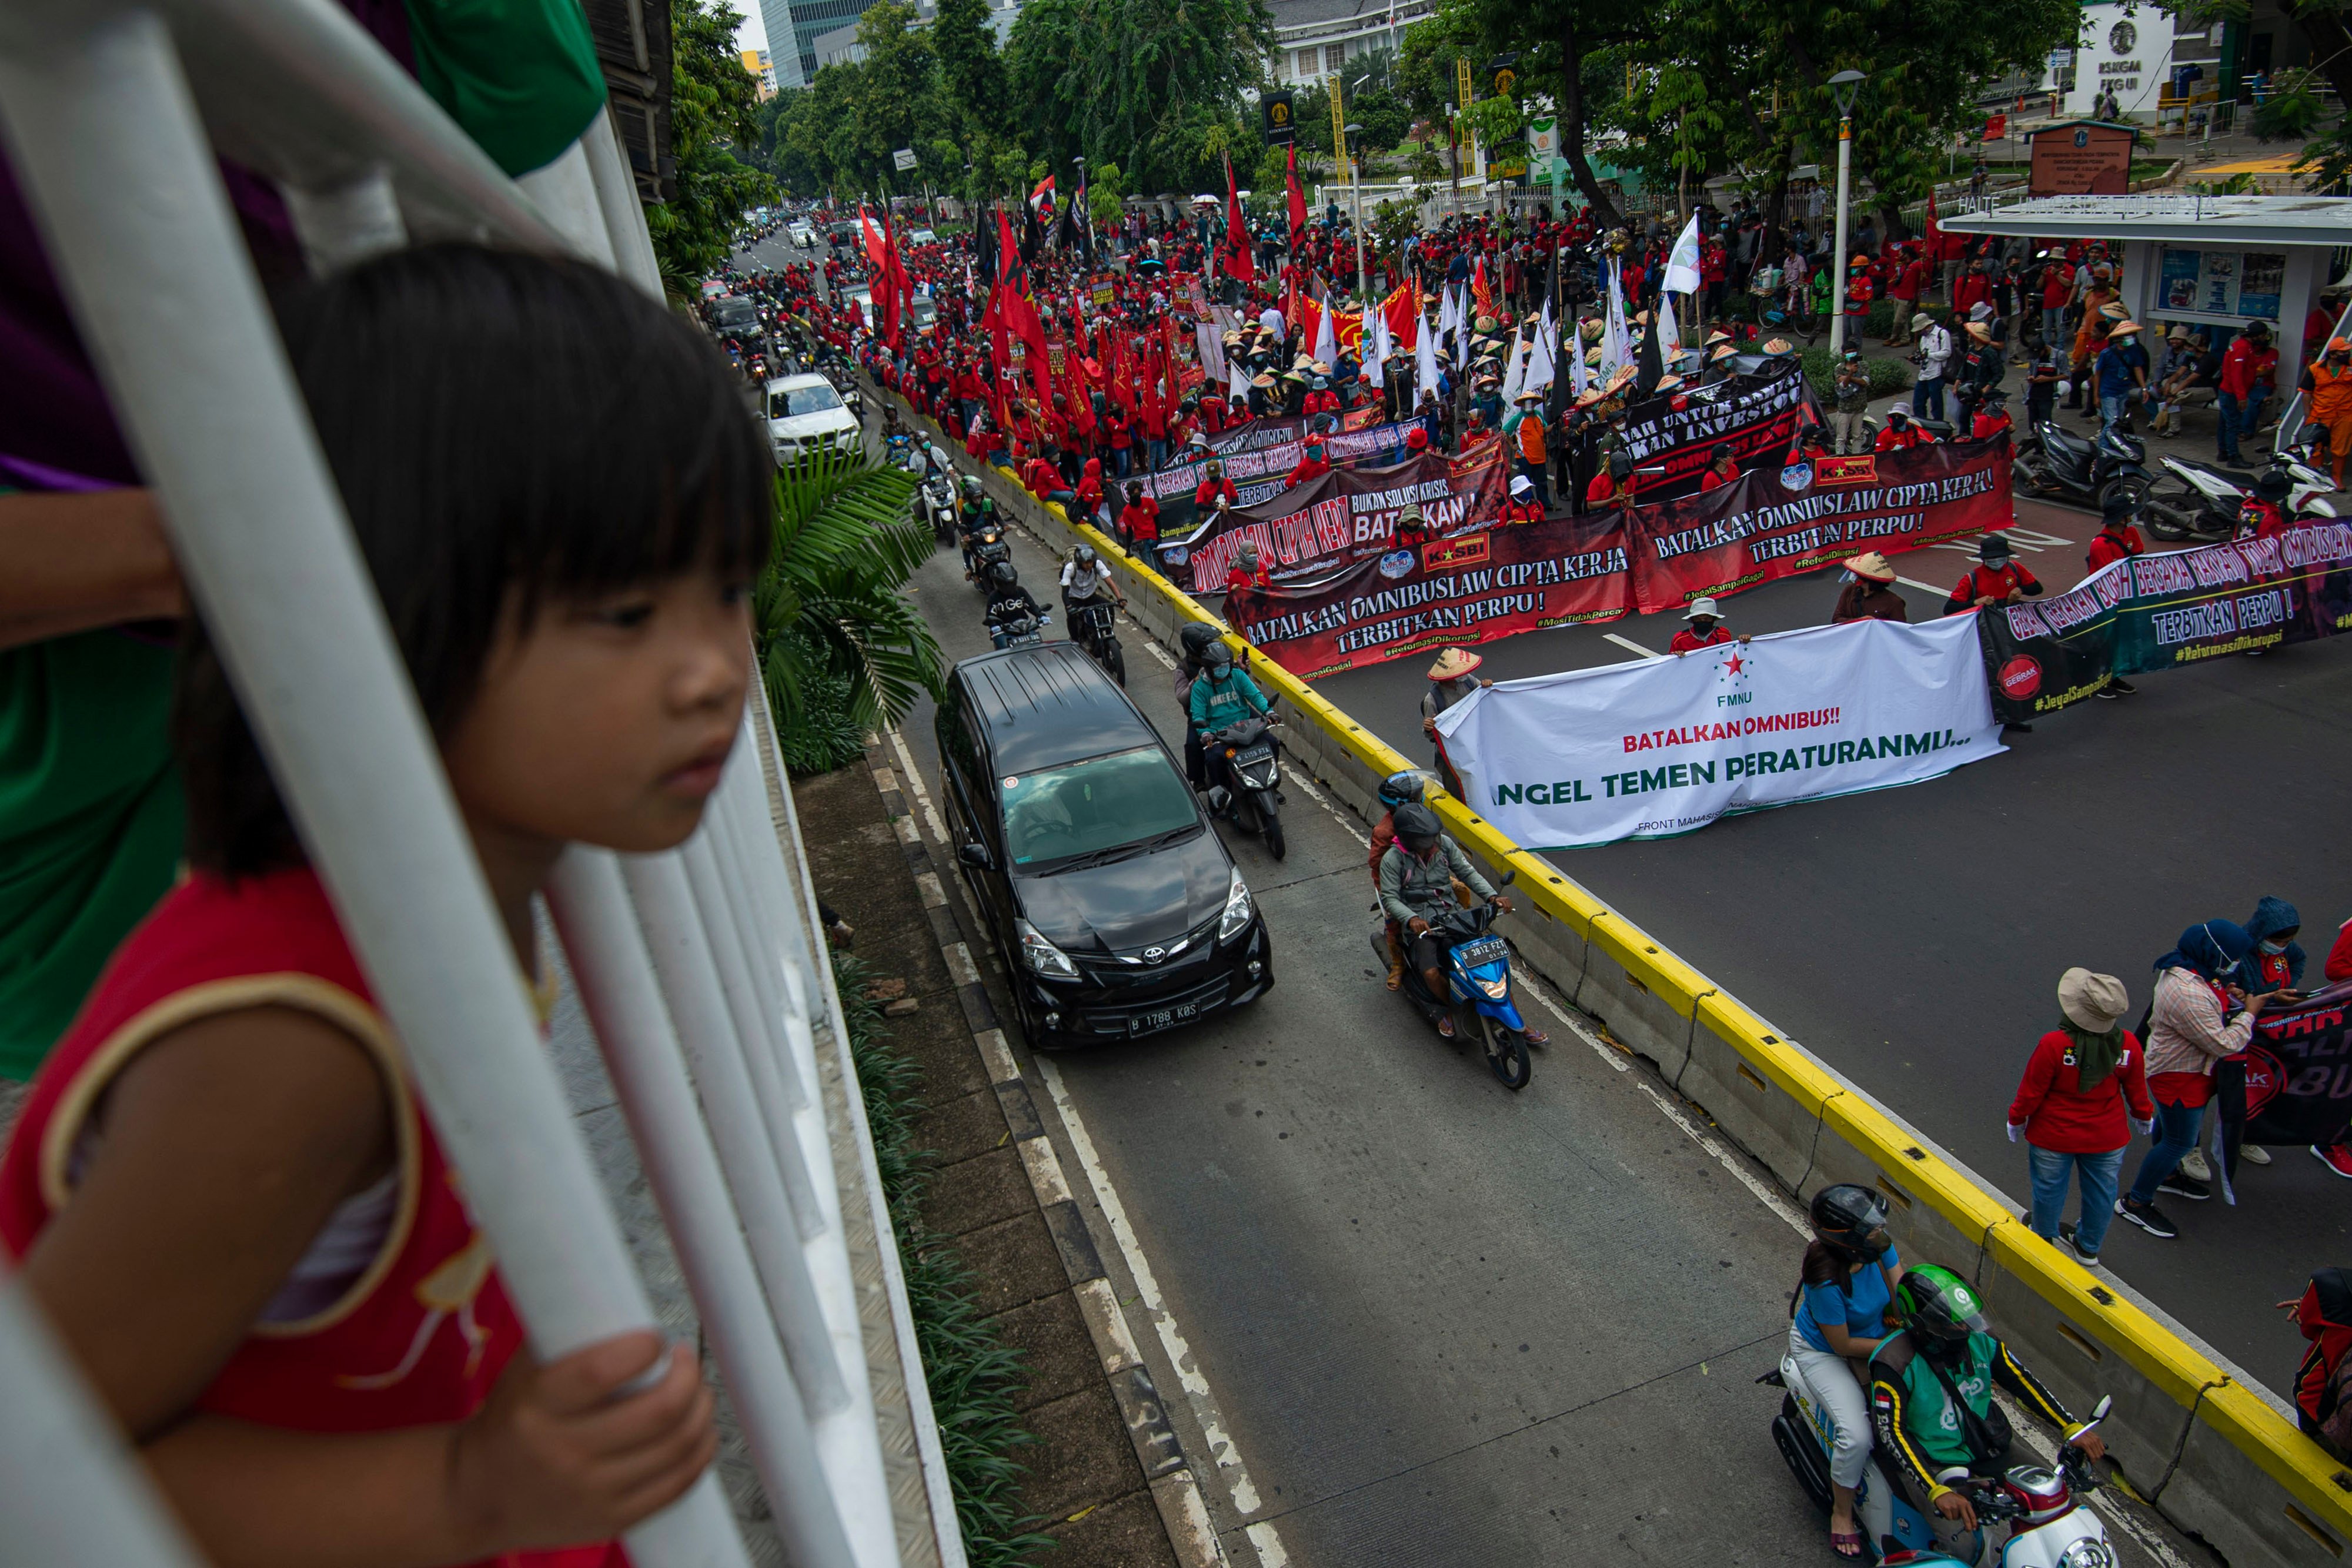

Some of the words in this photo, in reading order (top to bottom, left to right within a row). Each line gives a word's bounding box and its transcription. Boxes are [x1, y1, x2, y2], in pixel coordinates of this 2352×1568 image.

[2099, 60, 2141, 74] RSKGM
[2100, 78, 2124, 90] FKG
[2126, 78, 2138, 90] UI
[1959, 196, 1999, 213] HALTE
[1226, 454, 1264, 479] BERSAMA
[1352, 492, 1387, 514] BUKAN
[1385, 484, 1419, 509] SOLUSI
[1420, 478, 1448, 501] KRISIS
[1355, 496, 1464, 543] BATKAN
[1653, 510, 1757, 559] BATALKAN
[1886, 482, 1940, 508] CIPTA
[1846, 513, 1916, 540] PERPU
[1684, 570, 1765, 601] #JegalSampaiGagal
[2132, 556, 2196, 597] BERSAMA
[1246, 600, 1347, 647] BATALKAN
[1351, 569, 1493, 621] OMNIBUSLAW
[1496, 560, 1560, 587] CIPTA
[1563, 547, 1628, 581] KERJA
[1335, 606, 1461, 655] TERBITKAN
[1463, 593, 1534, 624] PERPU
[1538, 591, 1545, 610] !
[2151, 599, 2235, 646] TERBITKAN
[2236, 590, 2284, 630] PERPU
[1384, 630, 1481, 657] #ReformasiDikorupsi
[2175, 629, 2283, 662] #ReformasiDikorupsi
[2006, 667, 2037, 687] GEBRAK
[1717, 691, 1753, 708] FMNU
[1623, 719, 1741, 754] BATALKAN
[1744, 707, 1840, 735] OMNIBUS!!
[1601, 760, 1716, 799] TEMEN
[1725, 728, 1972, 782] PERATURANMU...
[1471, 944, 1489, 957] 3812
[1490, 940, 1505, 951] FZT
[1132, 1019, 1139, 1031] B
[1146, 1011, 1171, 1026] 1788
